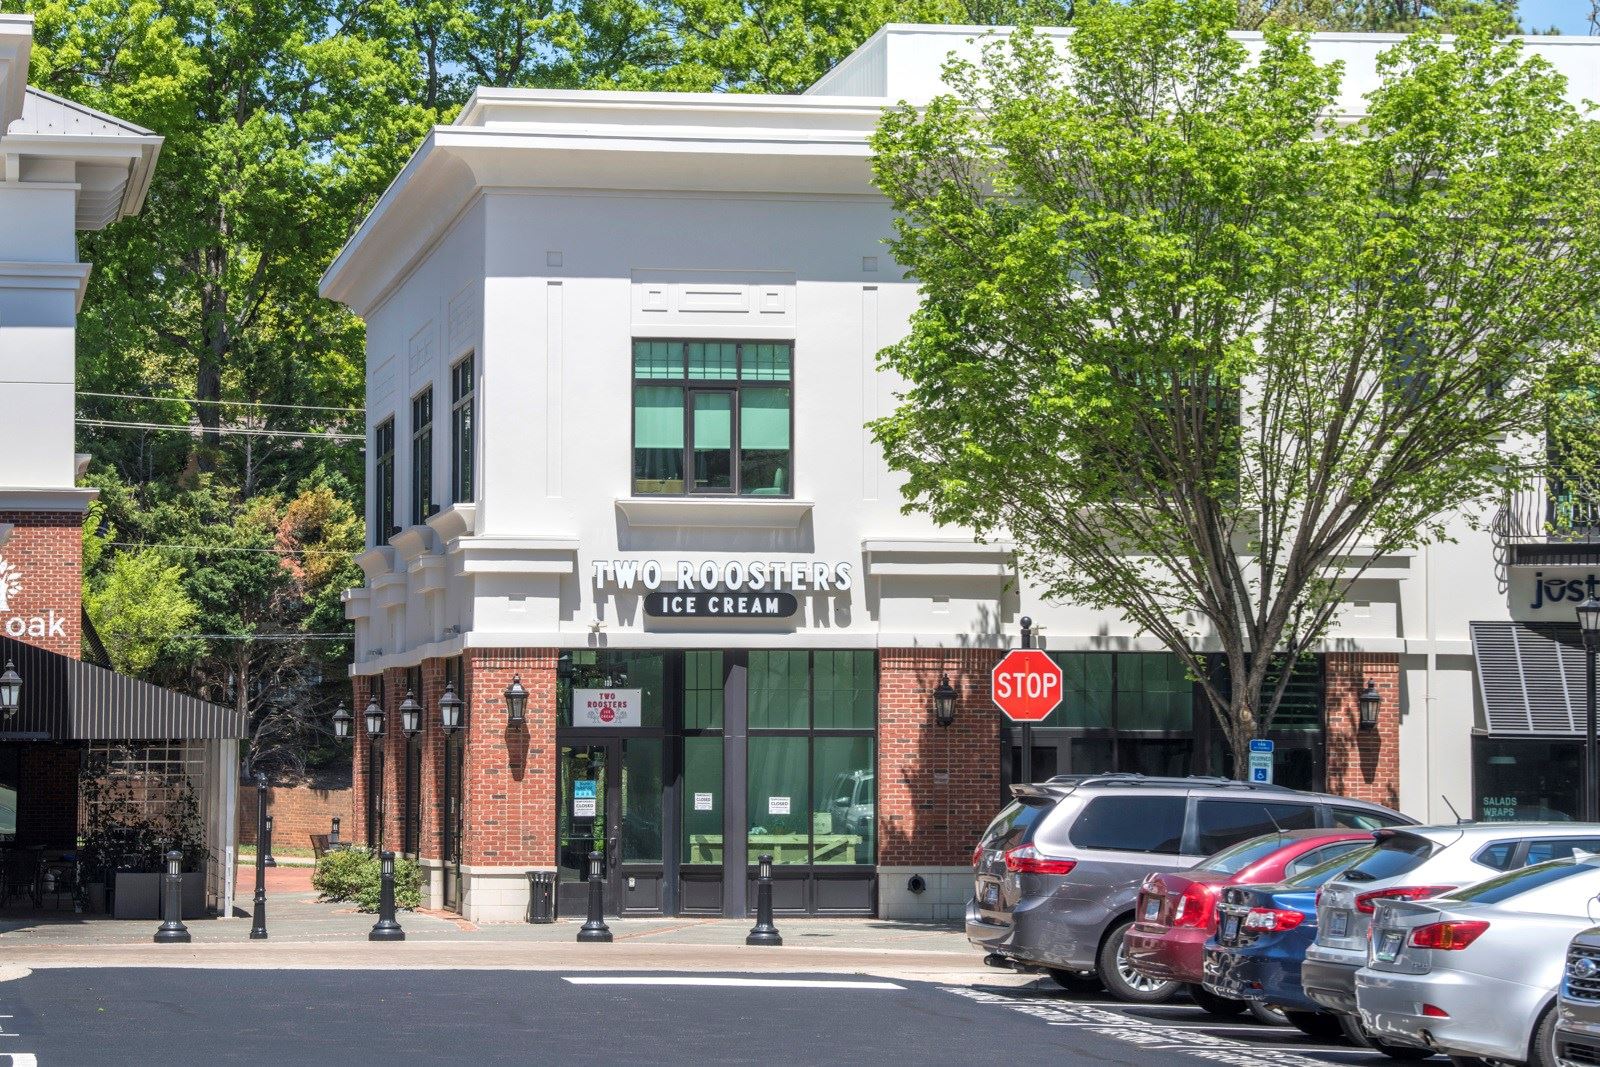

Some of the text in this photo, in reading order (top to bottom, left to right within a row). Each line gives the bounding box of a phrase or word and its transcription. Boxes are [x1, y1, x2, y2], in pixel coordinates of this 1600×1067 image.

[592, 560, 853, 591] TWO ROOSTERS
[1530, 571, 1600, 609] just
[662, 597, 779, 613] ICE CREAM
[5, 609, 67, 637] oak
[997, 672, 1058, 698] STOP
[587, 700, 628, 708] ROOSTERS
[598, 692, 616, 700] TWO
[1483, 797, 1518, 806] SALADS
[1483, 807, 1515, 817] WRAPS
